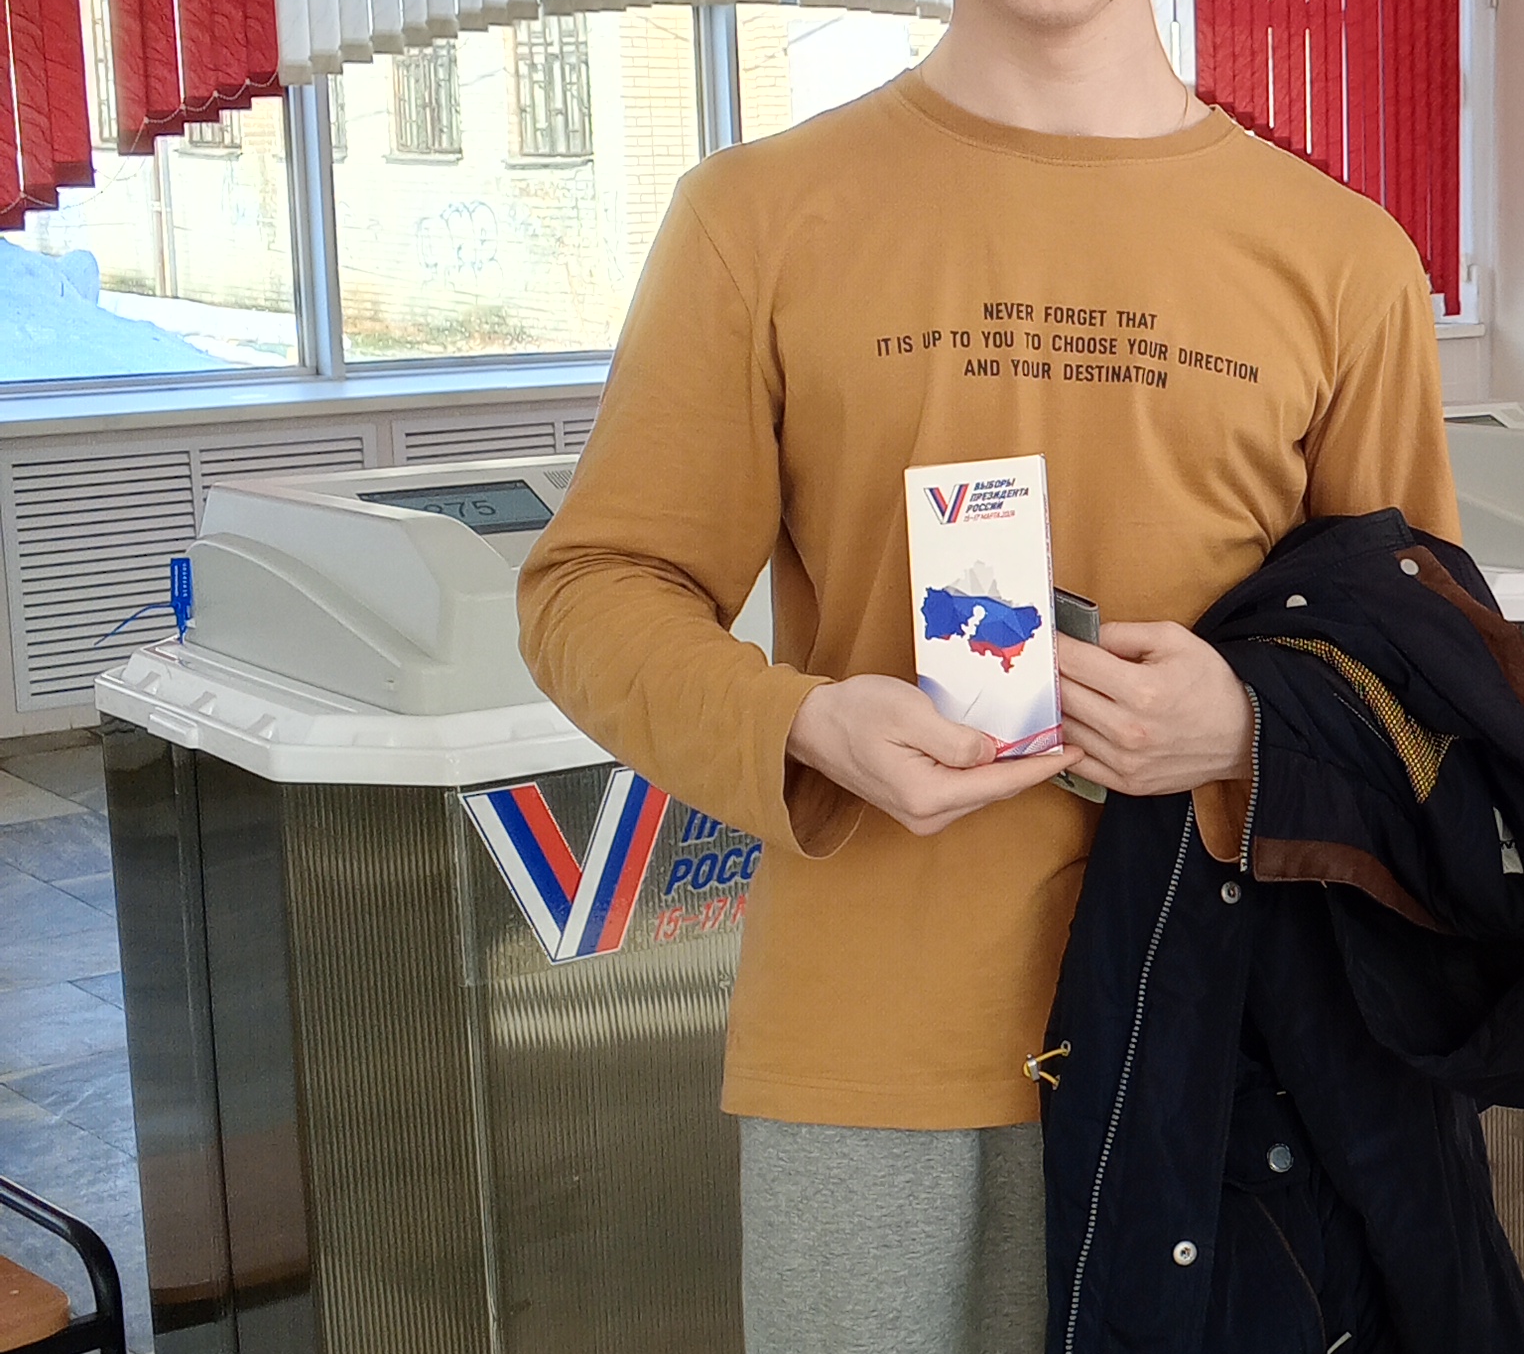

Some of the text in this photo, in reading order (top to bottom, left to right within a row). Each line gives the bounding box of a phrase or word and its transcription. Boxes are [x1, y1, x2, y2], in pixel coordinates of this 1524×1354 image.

[983, 302, 1158, 331] NEVER FORGET THAT
[876, 330, 1259, 385] IT IS UP TO YOU TO CHOOSE YOUR DIRECTION
[963, 358, 1168, 390] AND YOUR DESTINATION
[663, 842, 764, 897] РОСС
